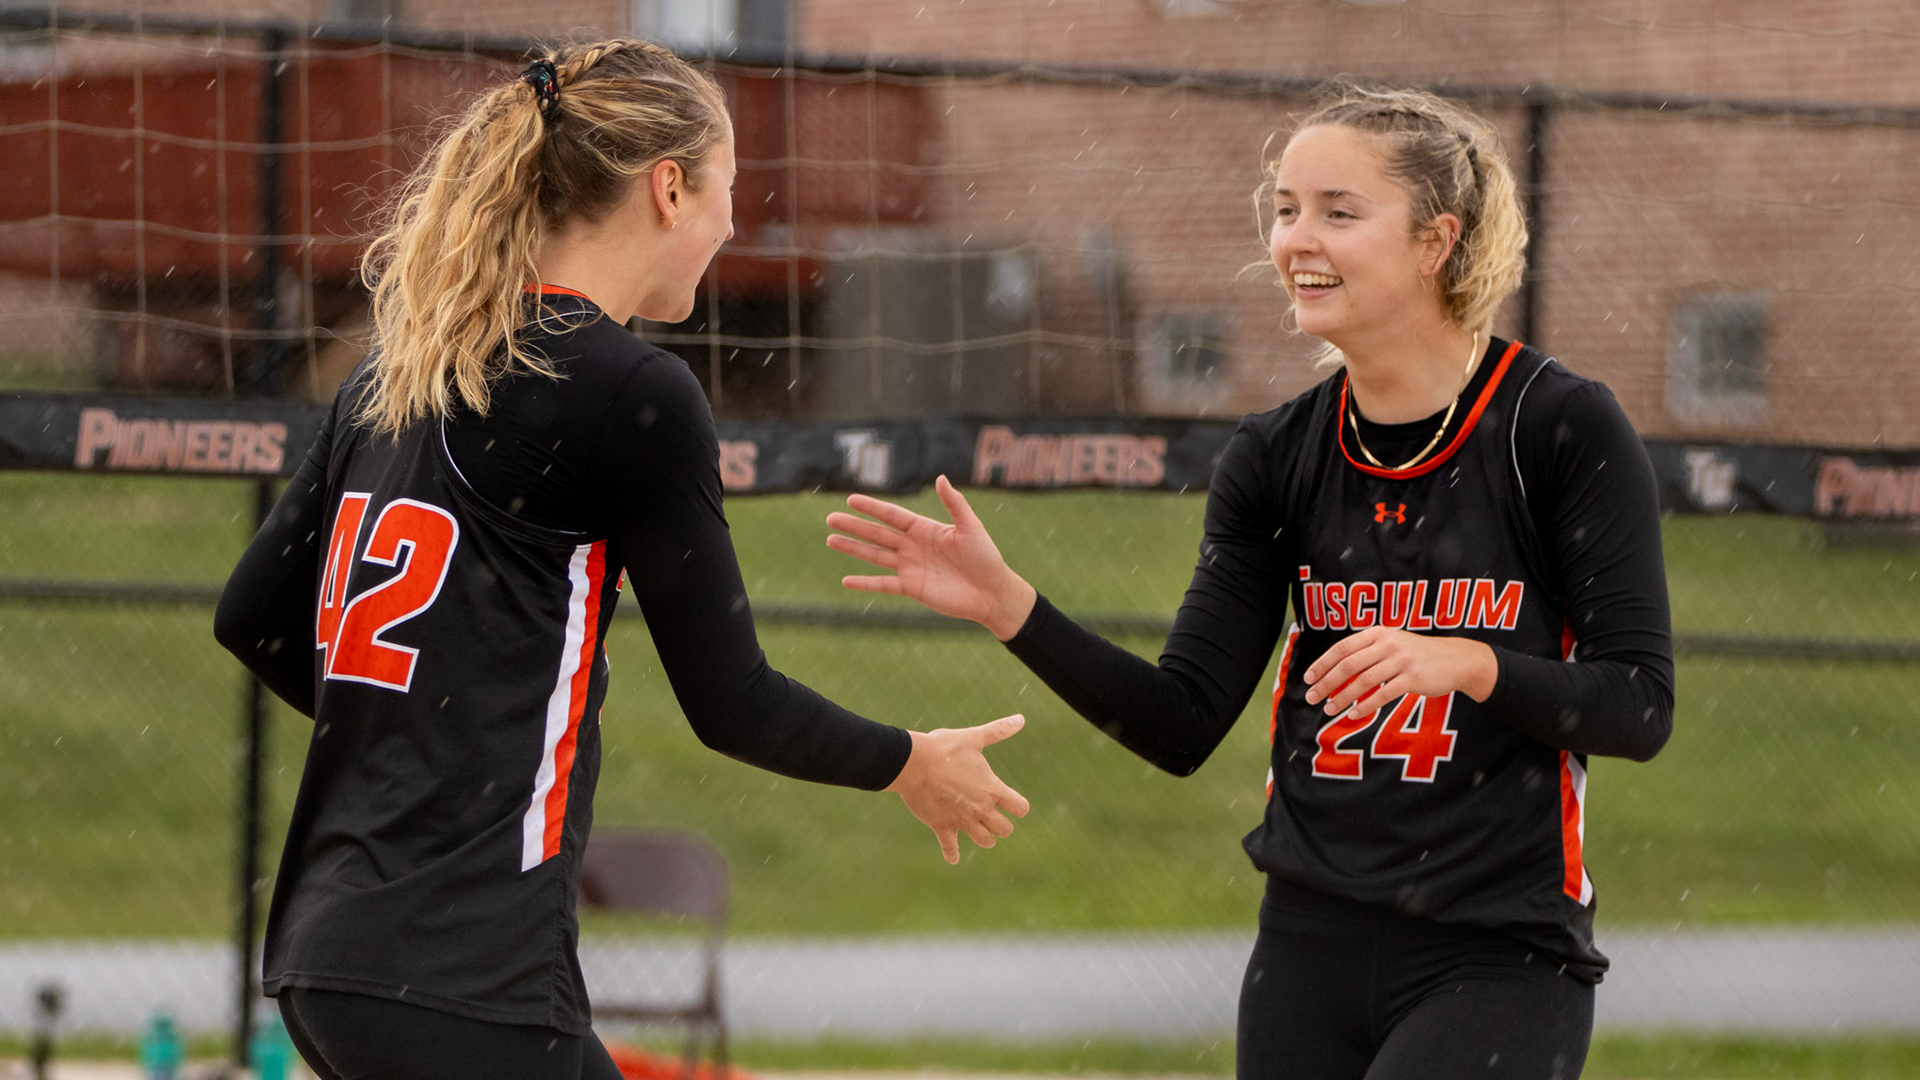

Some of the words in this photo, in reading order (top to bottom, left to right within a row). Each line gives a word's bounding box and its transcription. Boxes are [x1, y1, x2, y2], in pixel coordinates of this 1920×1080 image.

[74, 407, 289, 473] PIONEERS
[971, 424, 1168, 486] PIONEERS
[316, 491, 460, 693] 42
[1299, 565, 1524, 632] USCULUM
[1312, 672, 1458, 783] 24
